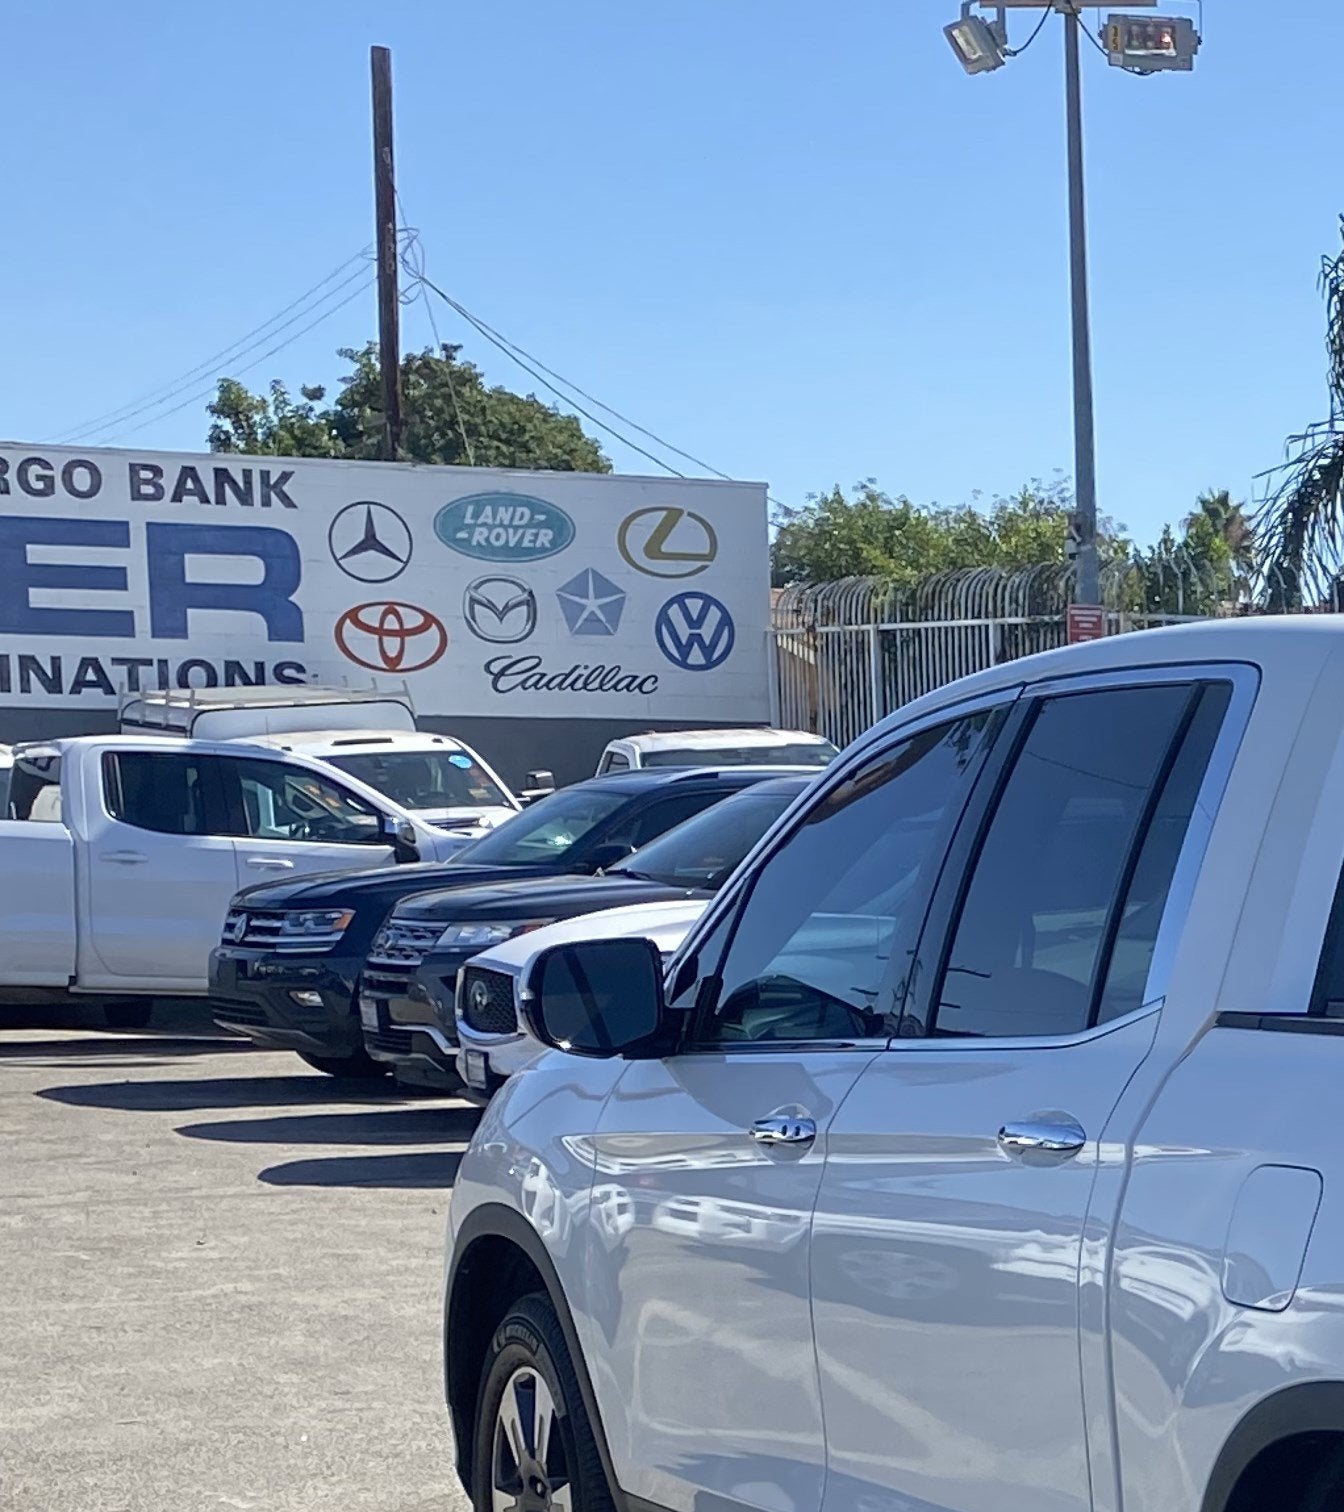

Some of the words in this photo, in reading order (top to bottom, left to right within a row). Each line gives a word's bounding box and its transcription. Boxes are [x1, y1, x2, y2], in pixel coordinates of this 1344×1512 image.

[0, 456, 102, 499] GO
[128, 462, 298, 509] BANK
[0, 515, 304, 643] ER
[483, 655, 658, 695] Cadillac
